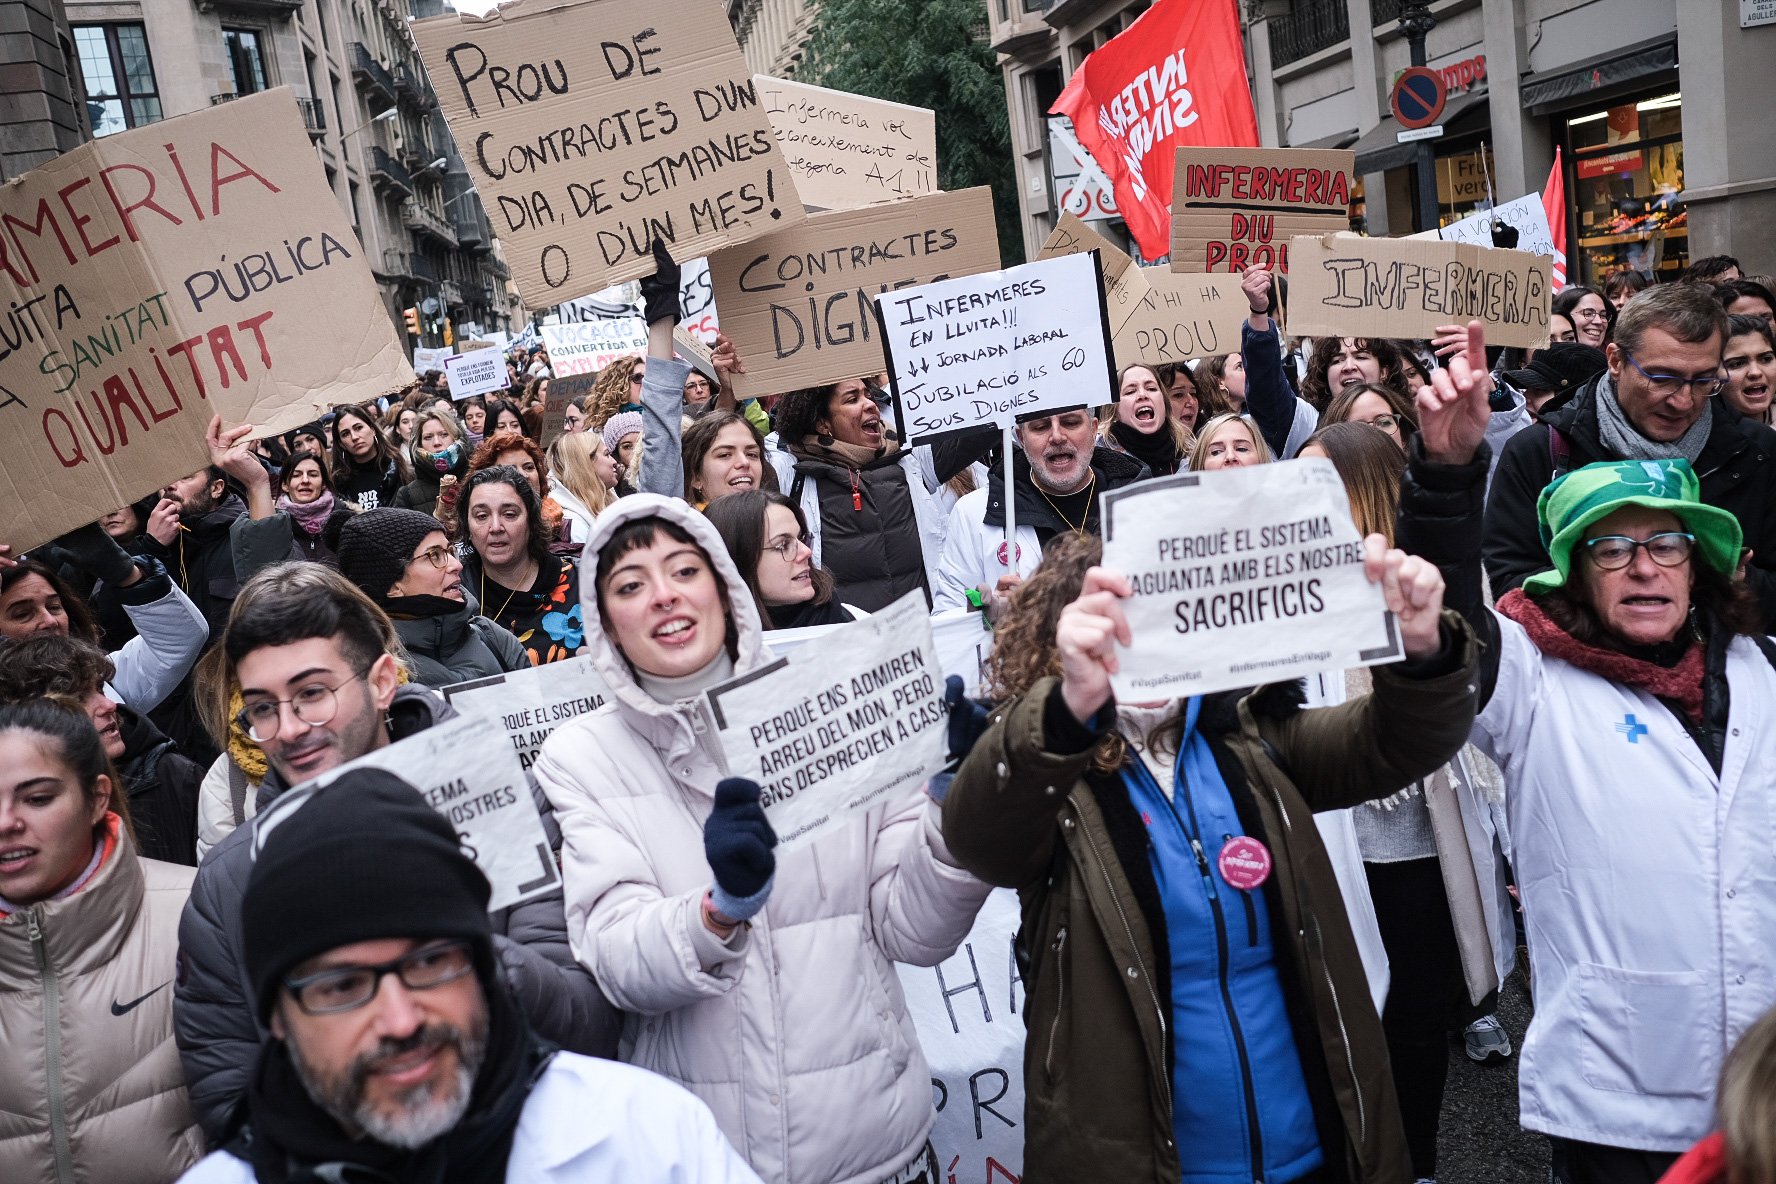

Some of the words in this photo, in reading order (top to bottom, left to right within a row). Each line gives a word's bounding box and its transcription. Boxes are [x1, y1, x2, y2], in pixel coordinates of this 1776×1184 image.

[445, 41, 569, 119] PROU
[600, 27, 662, 81] DE
[475, 100, 679, 181] CONTRACTES
[693, 78, 757, 122] D'UN
[497, 190, 565, 233] DIA,
[566, 178, 614, 219] DE
[619, 129, 772, 203] SETMANES
[788, 155, 847, 178] tegoria
[905, 150, 932, 169] de
[1458, 157, 1492, 177] Frui
[1186, 164, 1350, 206] INFERMERIA
[540, 243, 571, 288] O
[597, 211, 675, 267] D'UN
[690, 169, 782, 235] MES!
[1231, 212, 1274, 244] DIU
[738, 227, 959, 293] CONTRACTES
[39, 291, 169, 394] SANITAT
[184, 232, 352, 313] PÚBLICA
[895, 278, 1047, 326] INFERMERES
[1199, 285, 1221, 303] HA
[1322, 257, 1549, 326] INFERMERA
[0, 283, 81, 361] UITA
[550, 318, 634, 344] VOCACIÓ
[769, 273, 951, 360] DIGN
[909, 330, 933, 349] EN
[946, 306, 1019, 340] LLUITA!!!
[1135, 319, 1218, 361] PROU
[551, 340, 629, 357] CONVERTIDA
[633, 337, 648, 347] EN
[936, 344, 1009, 368] JORNADA
[1014, 328, 1069, 350] LABORAL
[42, 311, 274, 468] QUALITAT
[461, 372, 495, 386] EXPLOTADES
[549, 377, 596, 395] DEMAN
[902, 370, 1019, 412] JUBILACIÓ
[1027, 365, 1048, 382] ALS
[1061, 346, 1086, 371] 60
[908, 411, 965, 437] SOUS
[970, 389, 1040, 421] DIGNES
[1158, 527, 1229, 562] PERQUÈ
[1235, 529, 1255, 552] EL
[1259, 515, 1334, 549] SISTEMA
[1126, 567, 1216, 597] 'AGUANTA
[1220, 557, 1258, 586] AMB
[1265, 550, 1294, 579] ELS
[1300, 540, 1364, 572] NOSTRE
[1175, 578, 1325, 634] SACRIFICIS
[534, 707, 551, 725] EL
[552, 693, 606, 721] SISTEMA
[750, 696, 819, 749] PERQUÈ
[817, 684, 848, 715] ENS
[850, 646, 926, 700] ADMIREN
[760, 731, 817, 778] ARREU
[817, 718, 848, 750] DEL
[849, 701, 894, 733] MÓN,
[892, 669, 934, 711] PERÒ
[760, 776, 795, 809] ENS
[795, 727, 896, 792] DESPRECIEN
[897, 719, 910, 743] A
[907, 698, 950, 734] CASA
[778, 813, 831, 846] VagaSanitat
